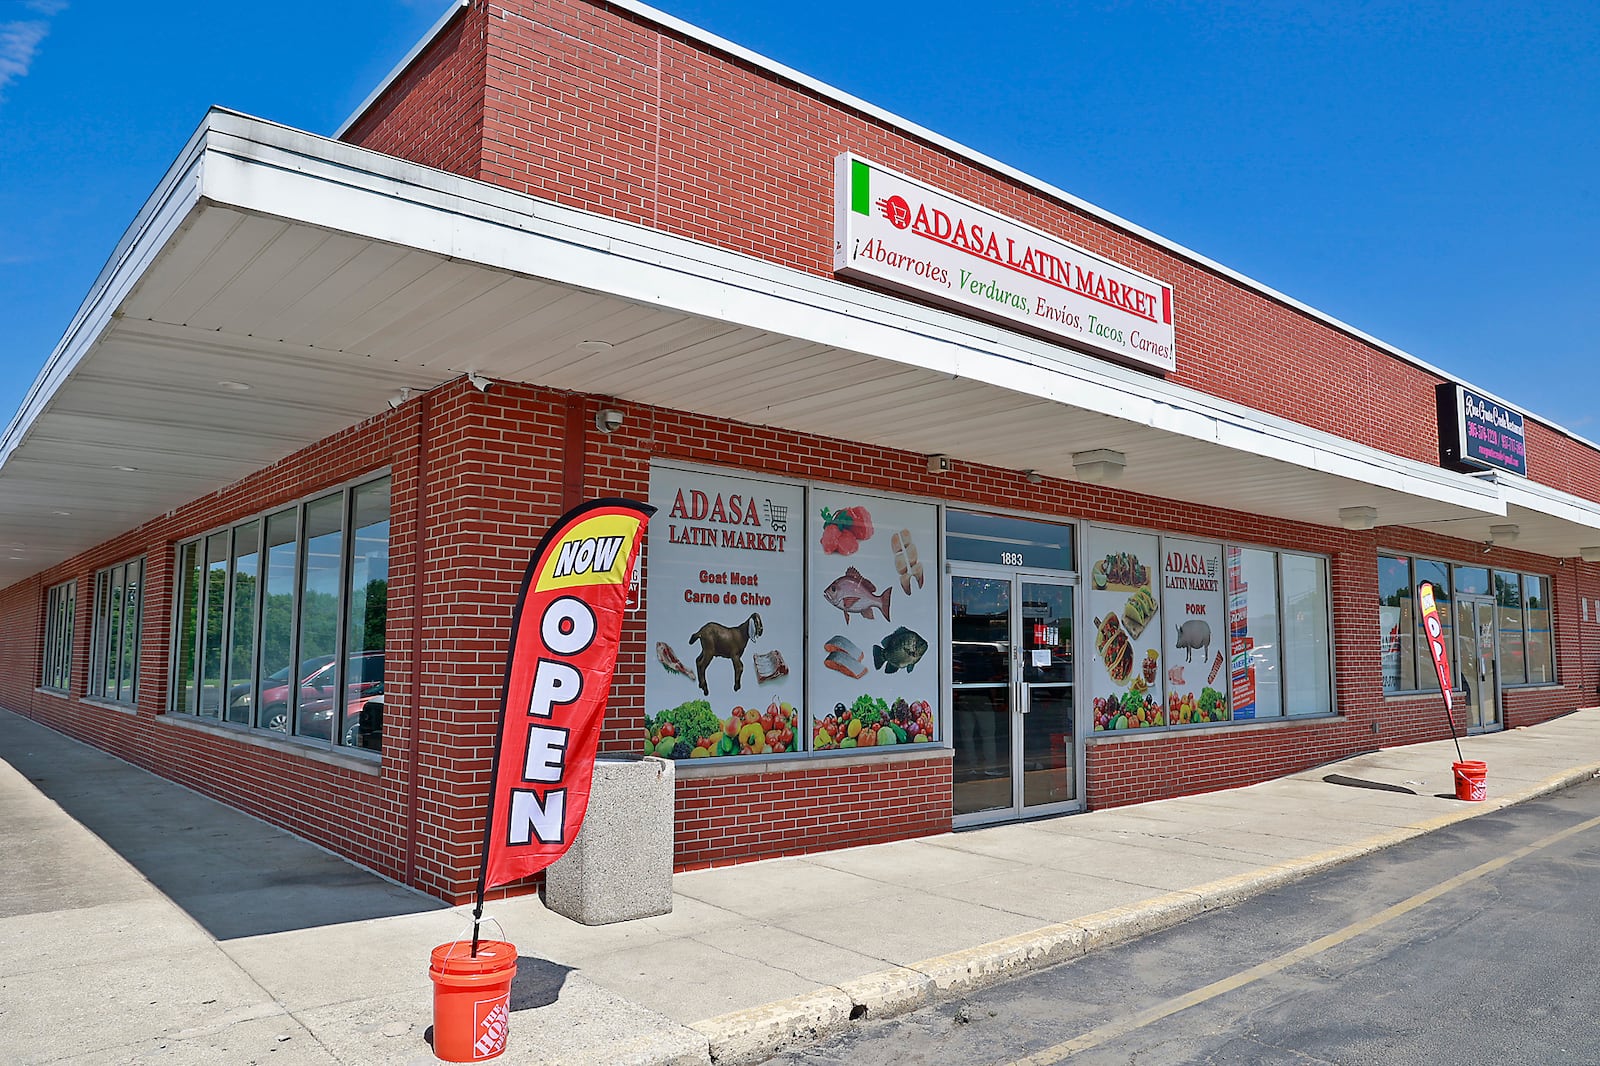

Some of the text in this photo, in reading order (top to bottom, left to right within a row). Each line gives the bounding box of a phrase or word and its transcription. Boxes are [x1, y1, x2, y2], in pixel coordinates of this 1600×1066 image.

[912, 203, 1157, 319] ADASA LATIN MARKET
[959, 268, 1031, 315] Verduras,
[1034, 296, 1084, 333] Envíos,
[1088, 314, 1126, 347] Tacos,
[1130, 330, 1173, 360] Carnes!
[669, 488, 761, 527] ADASA
[669, 525, 786, 552] LATIN MARKET
[552, 536, 625, 578] NOW
[1000, 552, 1023, 566] 1883
[1165, 551, 1207, 575] ADASA
[699, 570, 727, 584] Goat
[1165, 575, 1219, 592] LATIN MARKET
[740, 592, 771, 606] Chivo
[1185, 603, 1206, 615] PORK
[506, 595, 598, 847] OPEN
[480, 1003, 502, 1029] THE
